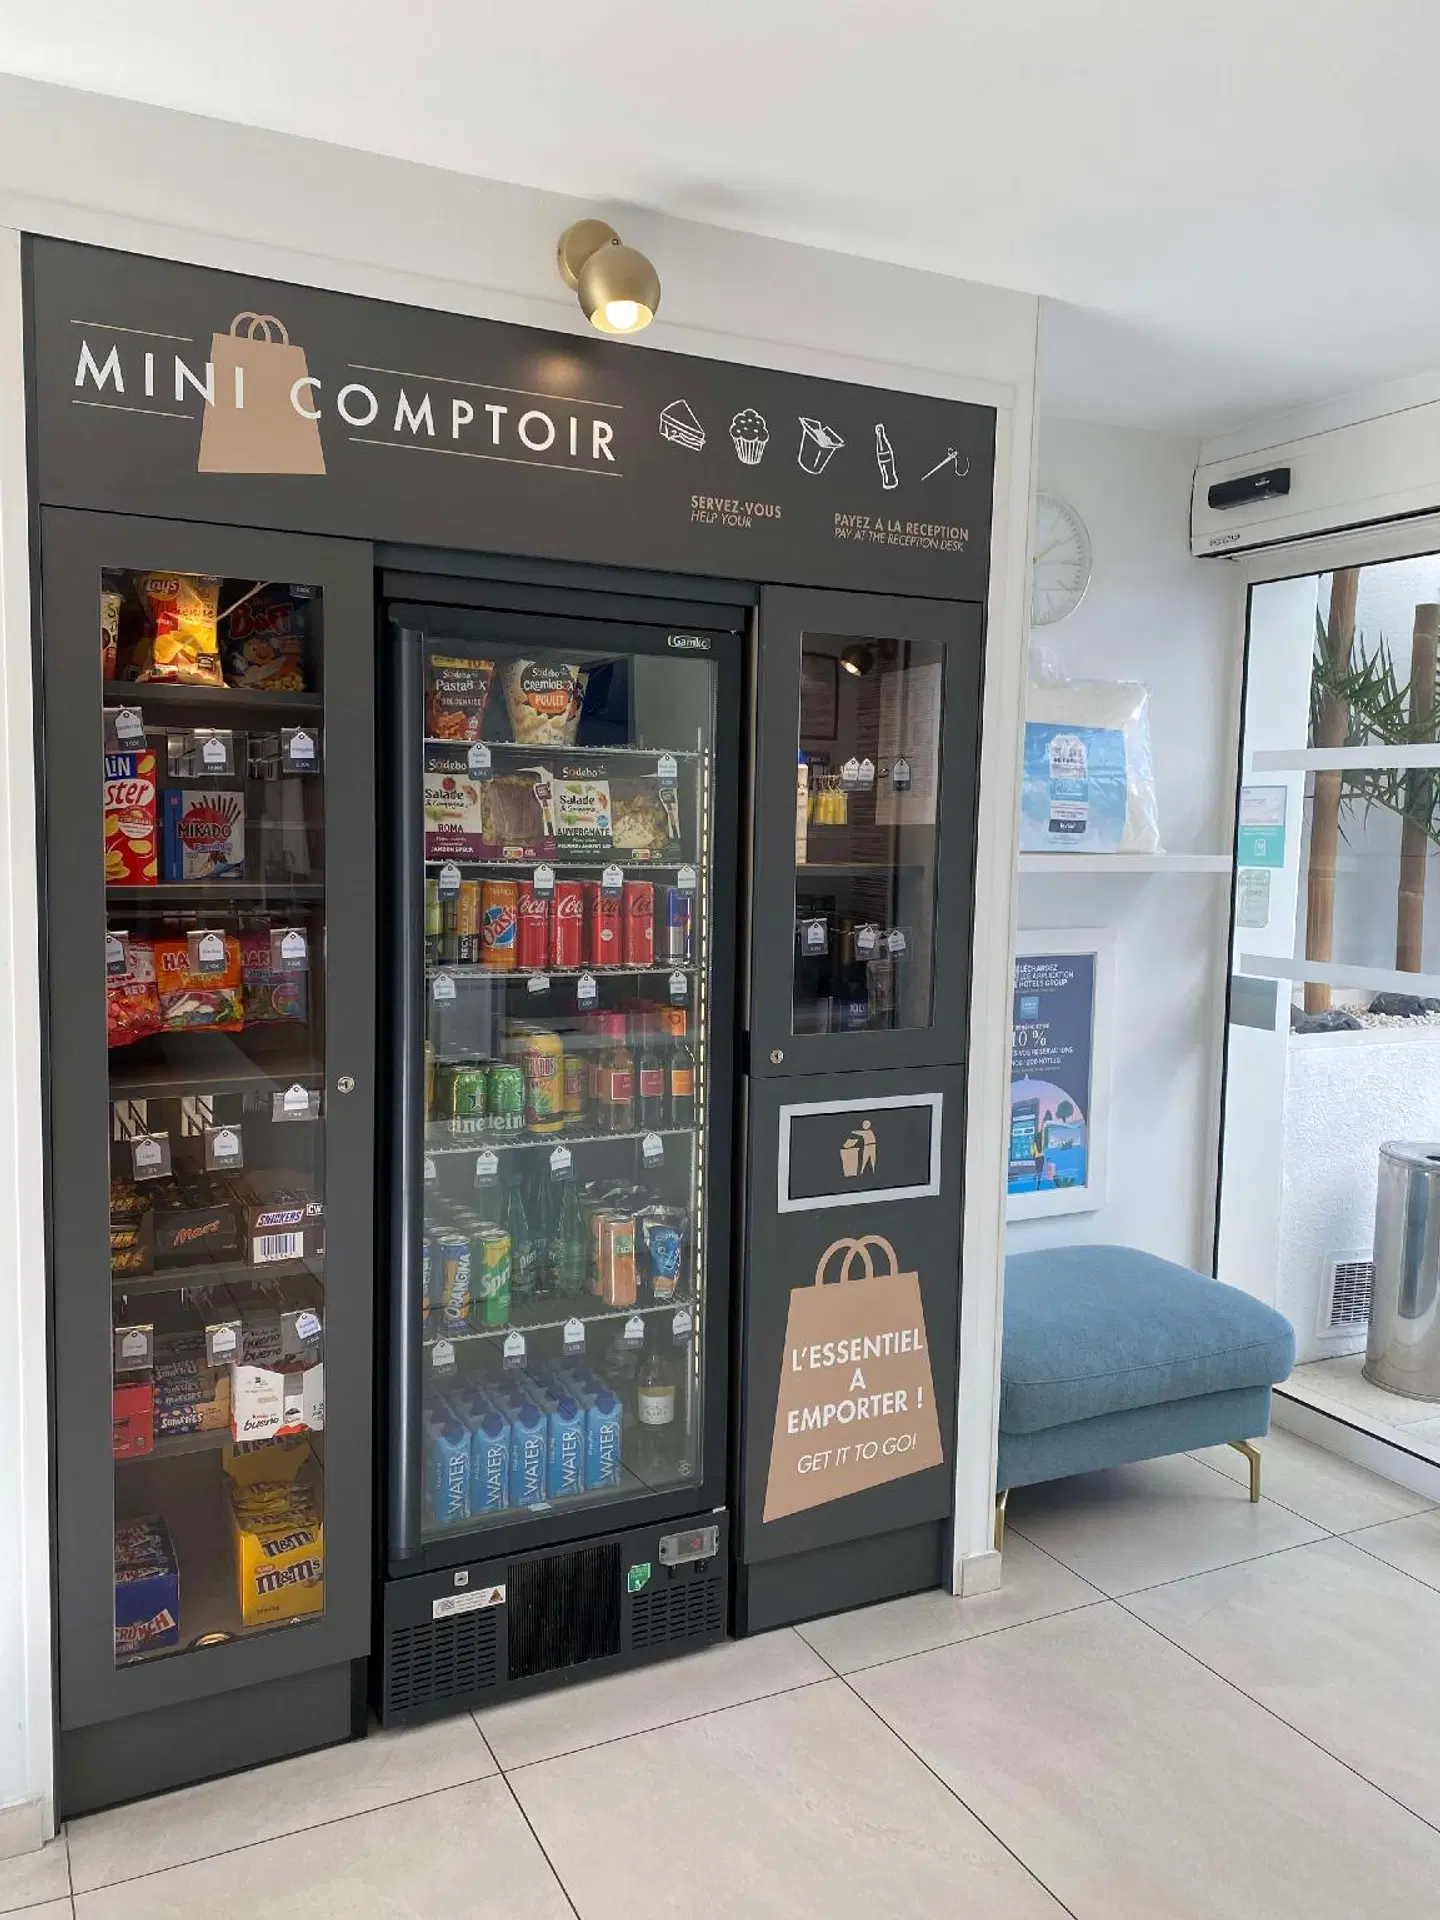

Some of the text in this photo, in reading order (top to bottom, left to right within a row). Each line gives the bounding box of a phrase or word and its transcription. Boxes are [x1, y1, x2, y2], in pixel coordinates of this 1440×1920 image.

[74, 340, 617, 462] MINI COMPTOIR
[691, 495, 782, 519] SERVEZ-VOUS
[691, 510, 752, 528] HELP YOUR
[834, 512, 970, 542] PAYEZ A LA RECEPTION
[834, 527, 965, 552] PAY AT THE RECEPTION DESK
[177, 822, 232, 839] MIKADO
[257, 1210, 304, 1227] SNICKERS
[443, 1253, 472, 1321] ORANGINA
[792, 1328, 924, 1373] L'ESSENTIEL
[850, 1367, 866, 1393] A
[787, 1386, 924, 1435] EMPORTER !
[525, 1437, 540, 1496] WATER
[562, 1430, 577, 1488] WATER
[600, 1423, 614, 1480] WATER
[797, 1432, 918, 1475] GET IT TO GO!
[447, 1455, 466, 1518] WATER
[485, 1447, 501, 1505] WATER
